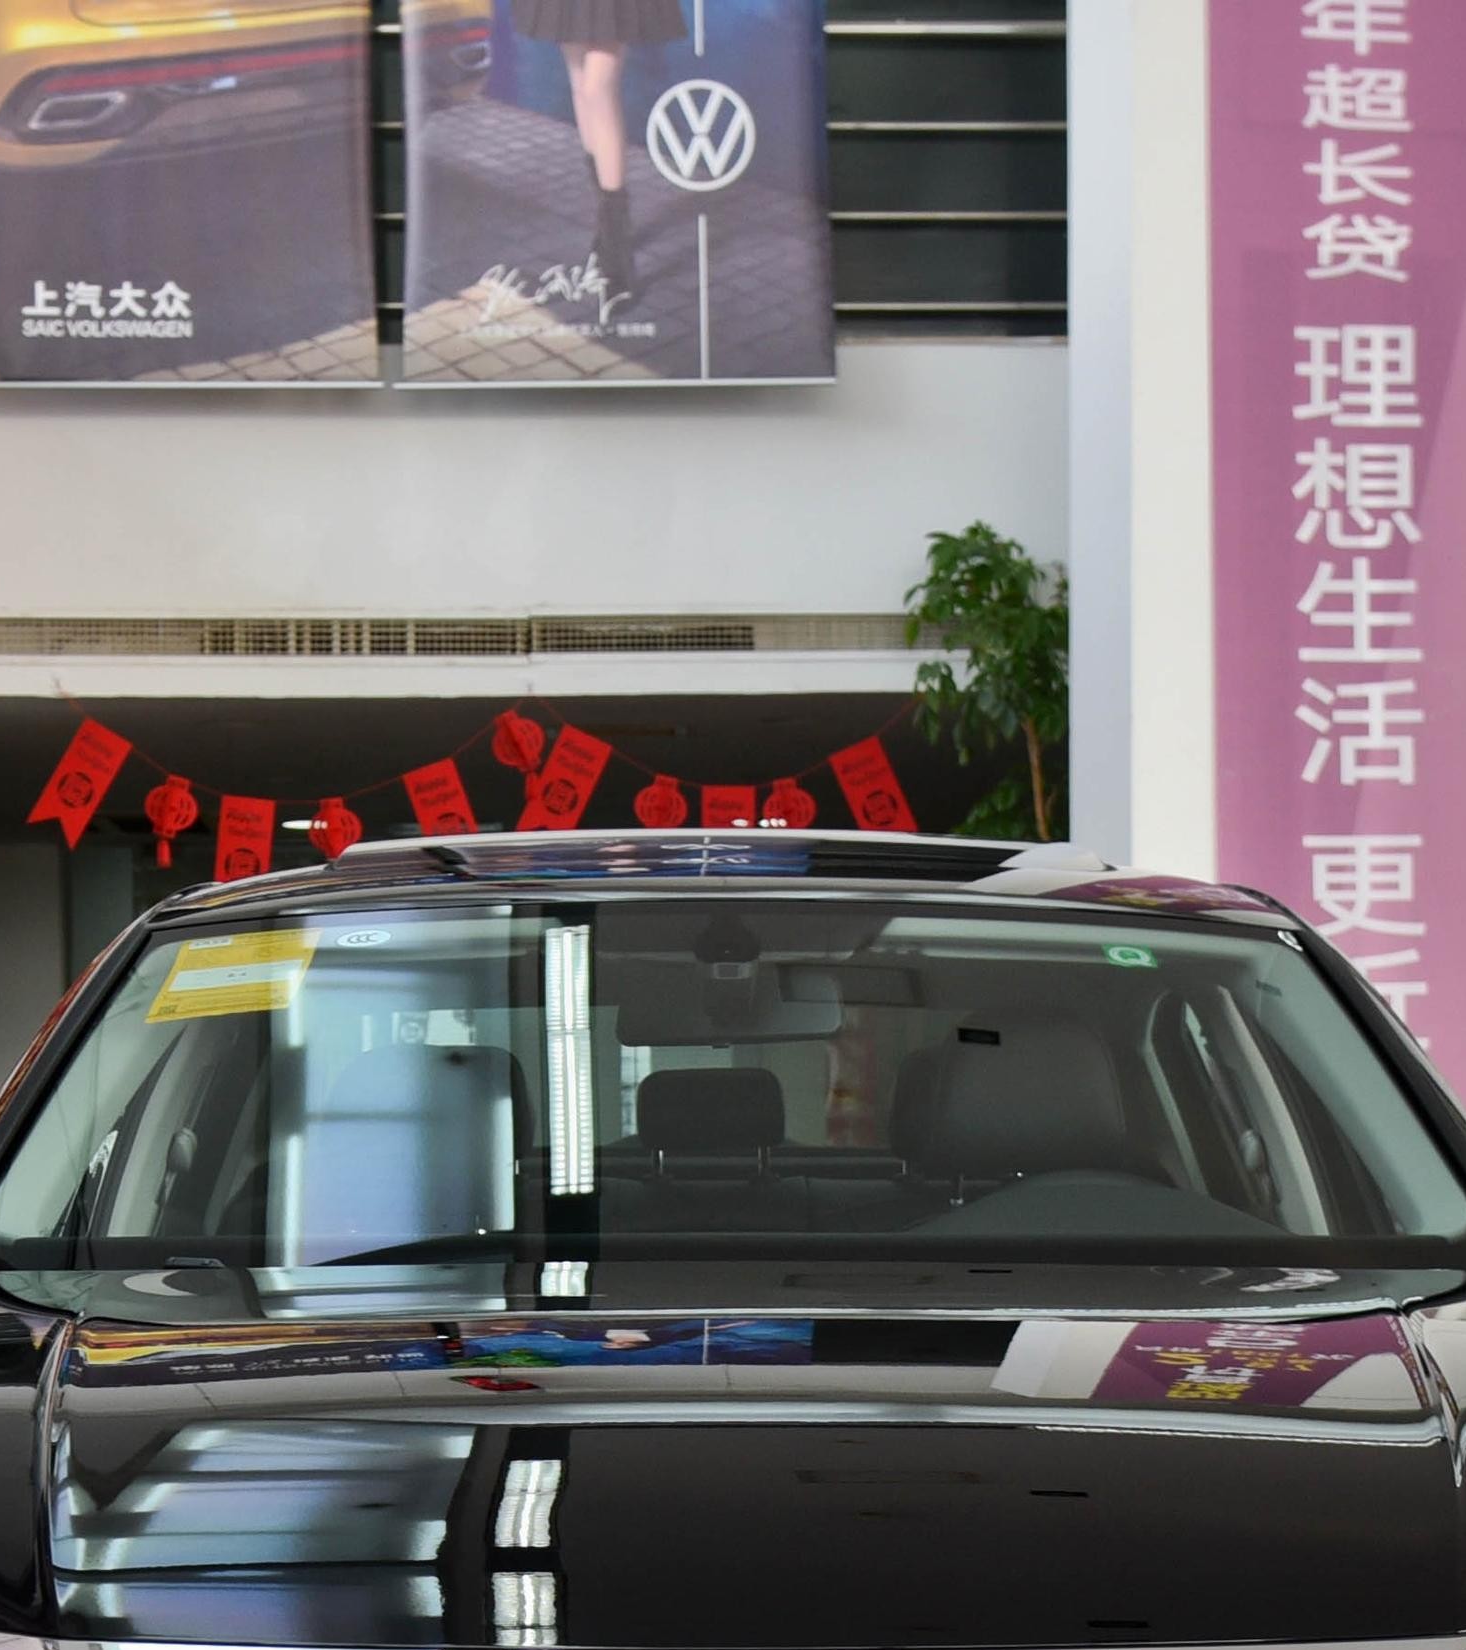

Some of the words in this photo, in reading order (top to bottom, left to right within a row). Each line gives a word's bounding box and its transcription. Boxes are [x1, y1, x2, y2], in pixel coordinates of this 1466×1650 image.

[1300, 0, 1414, 282] 年超长贷
[21, 280, 193, 319] 上汽大众
[21, 319, 66, 338] SAIC
[65, 319, 194, 339] VOLKSWAGEN
[1290, 324, 1426, 786] 理想生活
